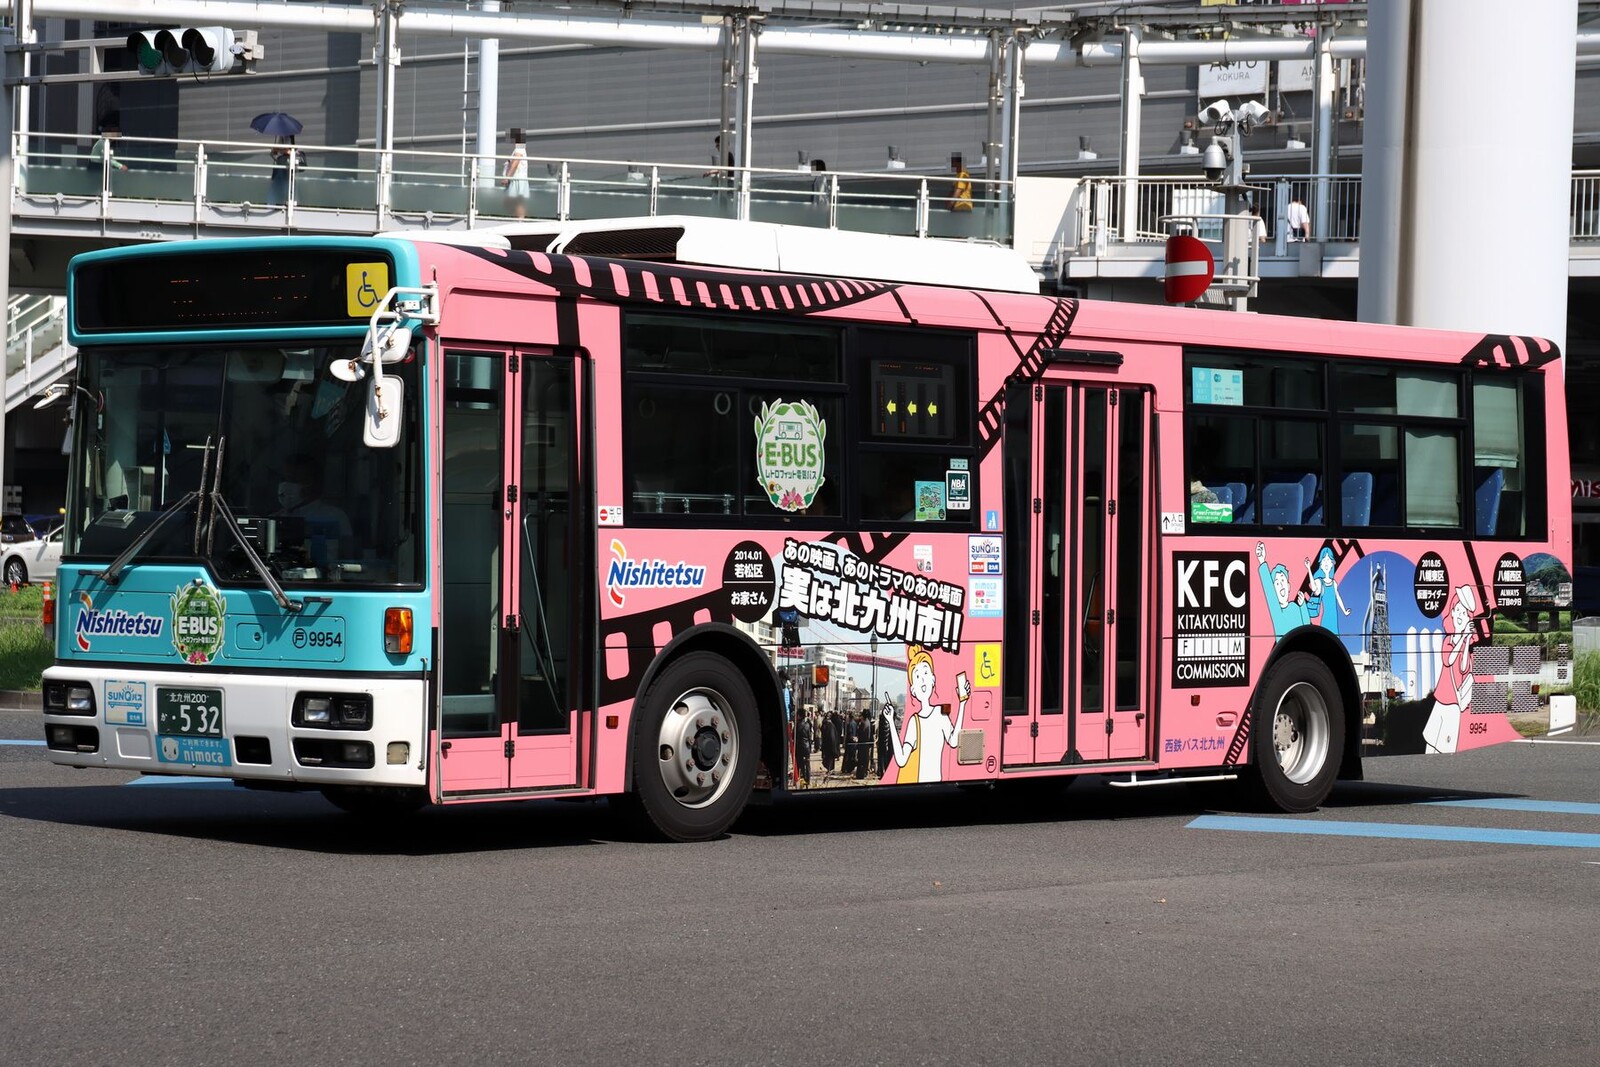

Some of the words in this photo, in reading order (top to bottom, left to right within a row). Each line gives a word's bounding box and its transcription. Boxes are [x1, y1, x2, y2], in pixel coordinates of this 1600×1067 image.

[1217, 72, 1250, 81] KOKURA
[765, 442, 817, 467] E-BUS
[950, 479, 966, 488] NBA
[734, 551, 762, 561] 2014.01
[1500, 560, 1519, 568] 2005.04
[608, 561, 704, 586] Nishitetsu
[734, 564, 763, 578] 若松区
[1419, 570, 1445, 582] 八幡東区
[1498, 570, 1522, 582] 八幡西区
[1177, 559, 1245, 608] KFC
[731, 591, 767, 605] お家さん
[76, 610, 162, 635] Nishitetsu
[178, 616, 218, 636] E-BUS
[1177, 614, 1245, 630] KITAKYUSHU
[309, 631, 342, 648] 9954
[1183, 639, 1242, 655] FILM
[1177, 663, 1245, 680] COMMISSION
[1469, 722, 1487, 734] 9954
[1165, 736, 1225, 752] 西鉄バス北九州
[184, 747, 223, 763] nimoca
